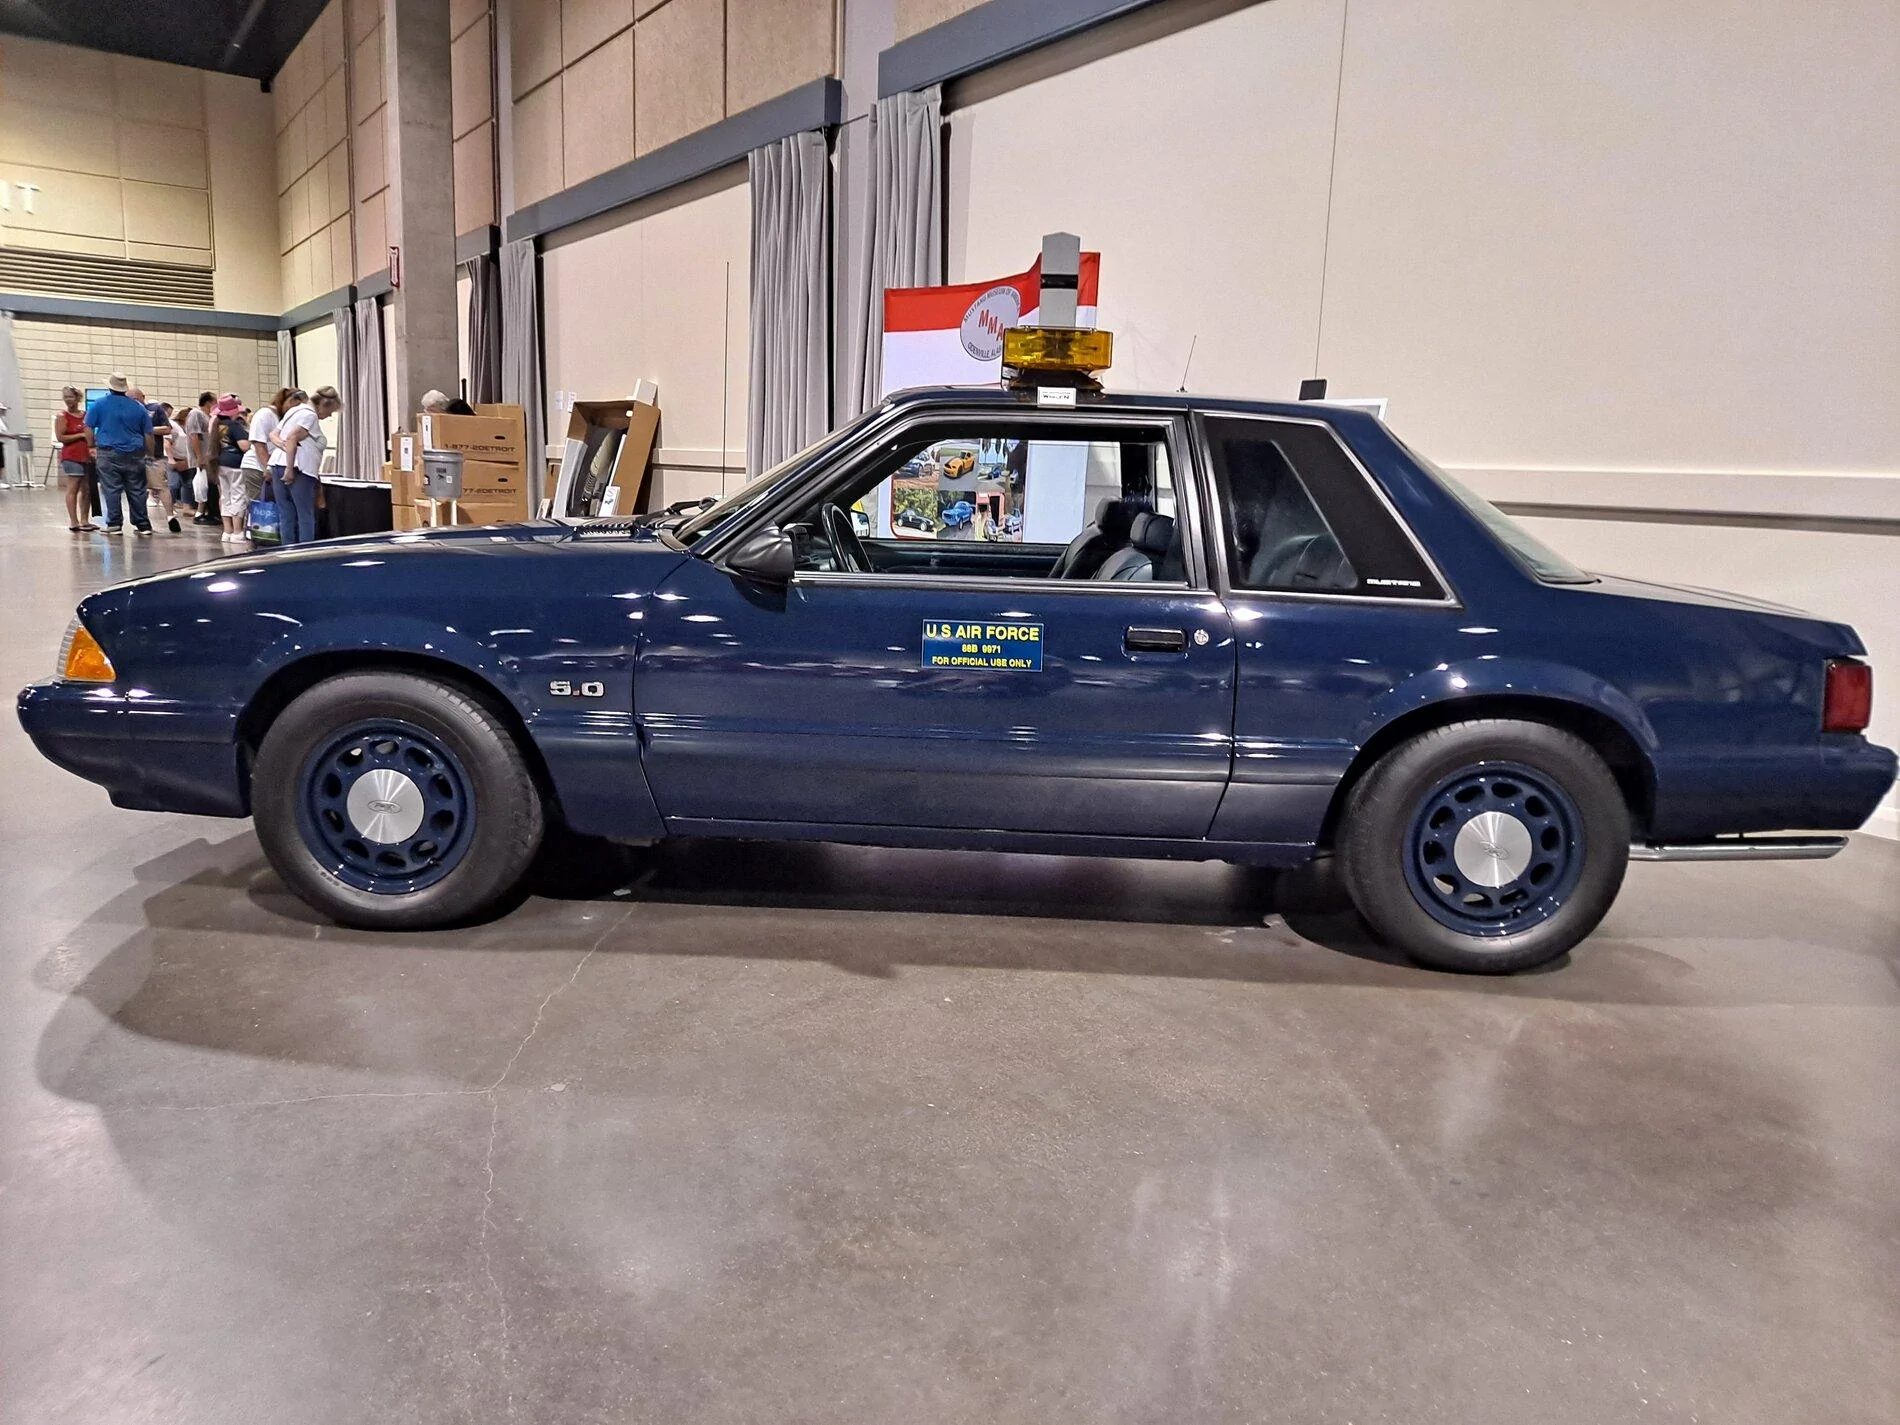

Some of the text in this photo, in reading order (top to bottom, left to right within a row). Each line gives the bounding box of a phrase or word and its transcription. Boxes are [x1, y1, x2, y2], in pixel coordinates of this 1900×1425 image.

[978, 309, 1004, 341] MMA
[926, 623, 1040, 641] U S AIR FORCE
[932, 656, 1032, 668] FOR OFFICIAL USE ONLY
[549, 680, 605, 697] 5.0
